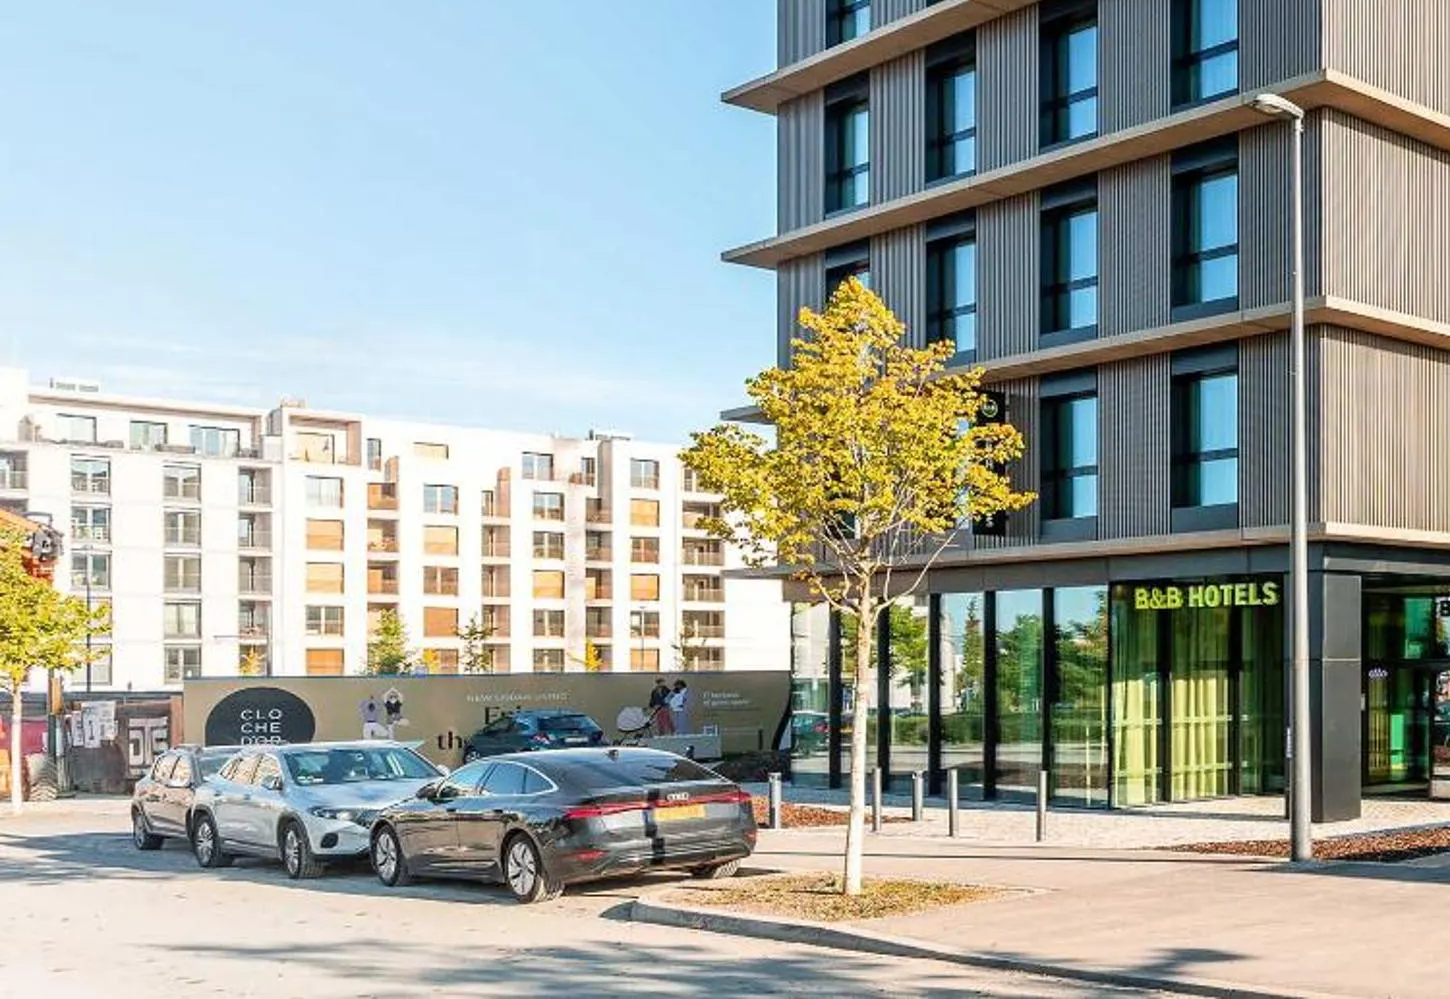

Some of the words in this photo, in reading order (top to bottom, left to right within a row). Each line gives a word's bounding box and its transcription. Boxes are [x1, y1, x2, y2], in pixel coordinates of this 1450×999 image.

[1134, 586, 1184, 610] B&B
[1188, 581, 1280, 608] HOTELS
[240, 708, 283, 720] CLO
[240, 722, 282, 734] CHE
[438, 730, 467, 750] th
